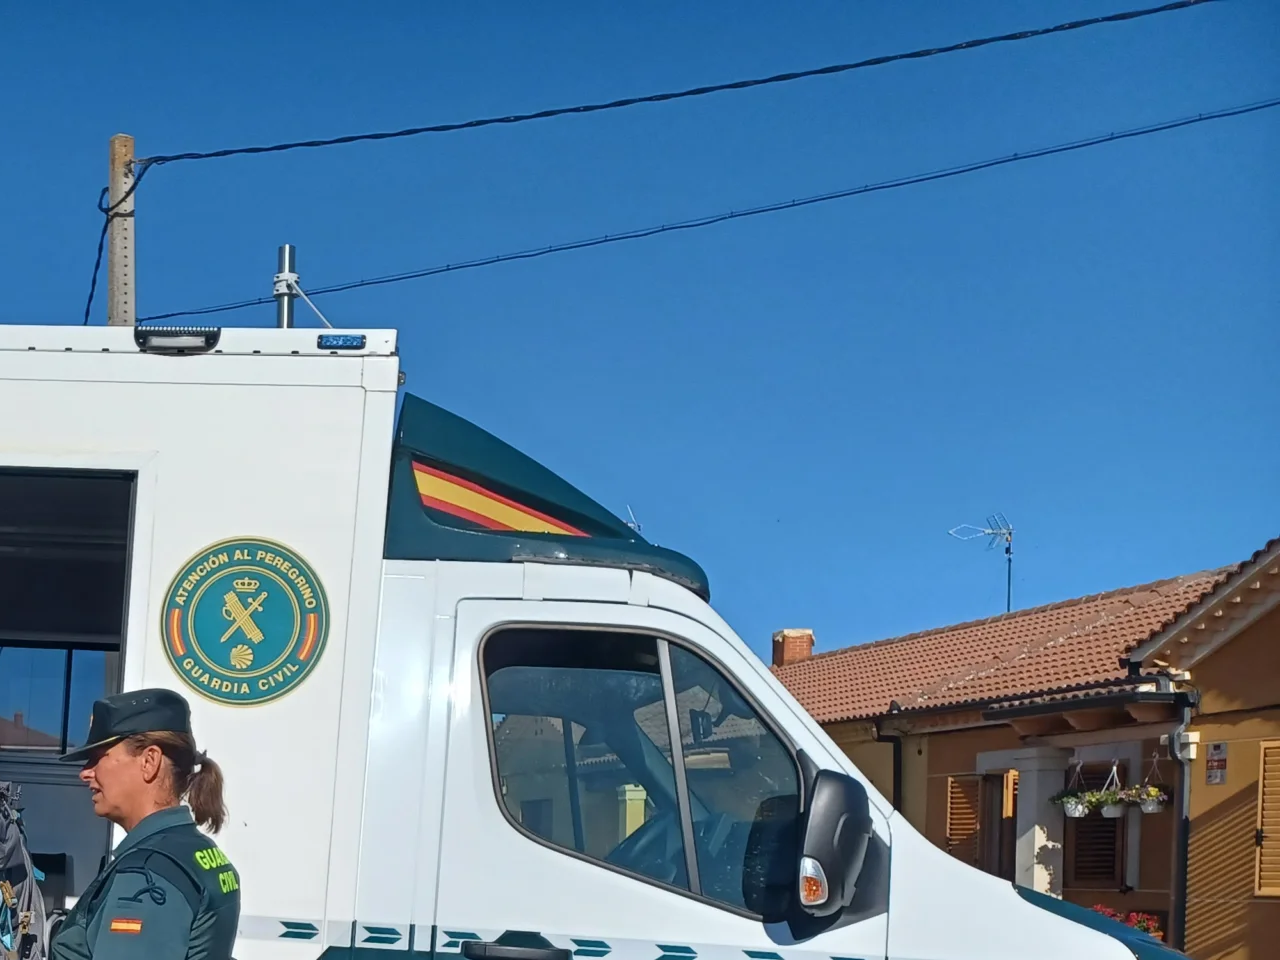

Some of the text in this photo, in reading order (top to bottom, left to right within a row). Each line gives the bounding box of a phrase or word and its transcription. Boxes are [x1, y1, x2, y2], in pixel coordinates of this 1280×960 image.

[174, 549, 317, 609] ATENCIÓN AL PEREGRINO
[182, 657, 300, 694] GUARDIA CIVIL
[219, 870, 239, 894] CIVIL
